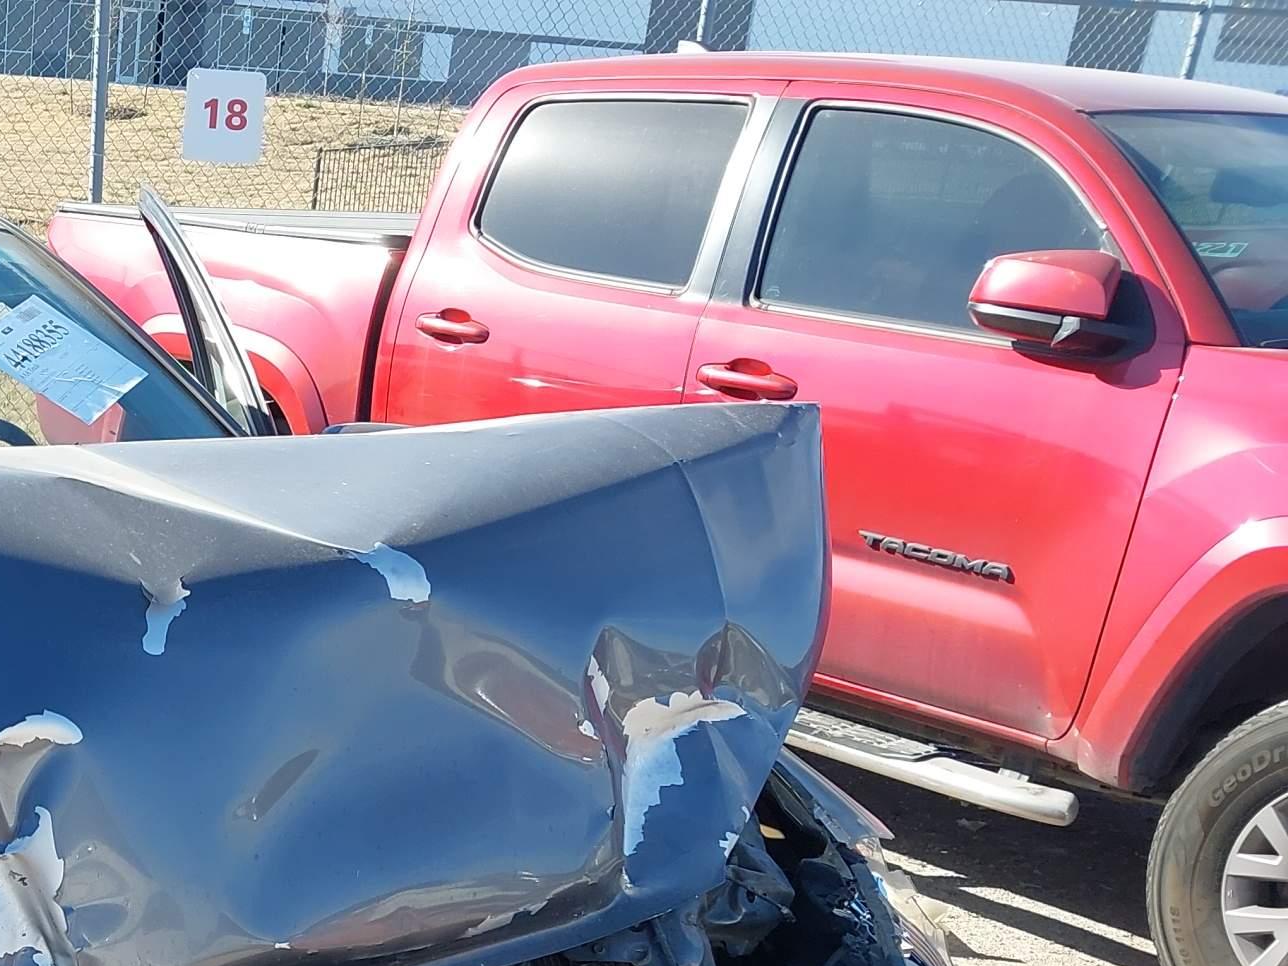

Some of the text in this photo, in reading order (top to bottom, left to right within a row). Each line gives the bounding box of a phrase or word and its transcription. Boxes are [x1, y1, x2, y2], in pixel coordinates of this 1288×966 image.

[204, 97, 248, 131] 18
[3, 319, 70, 369] 44188355
[858, 529, 1015, 583] TACOMA
[1208, 745, 1288, 808] GeoDr
